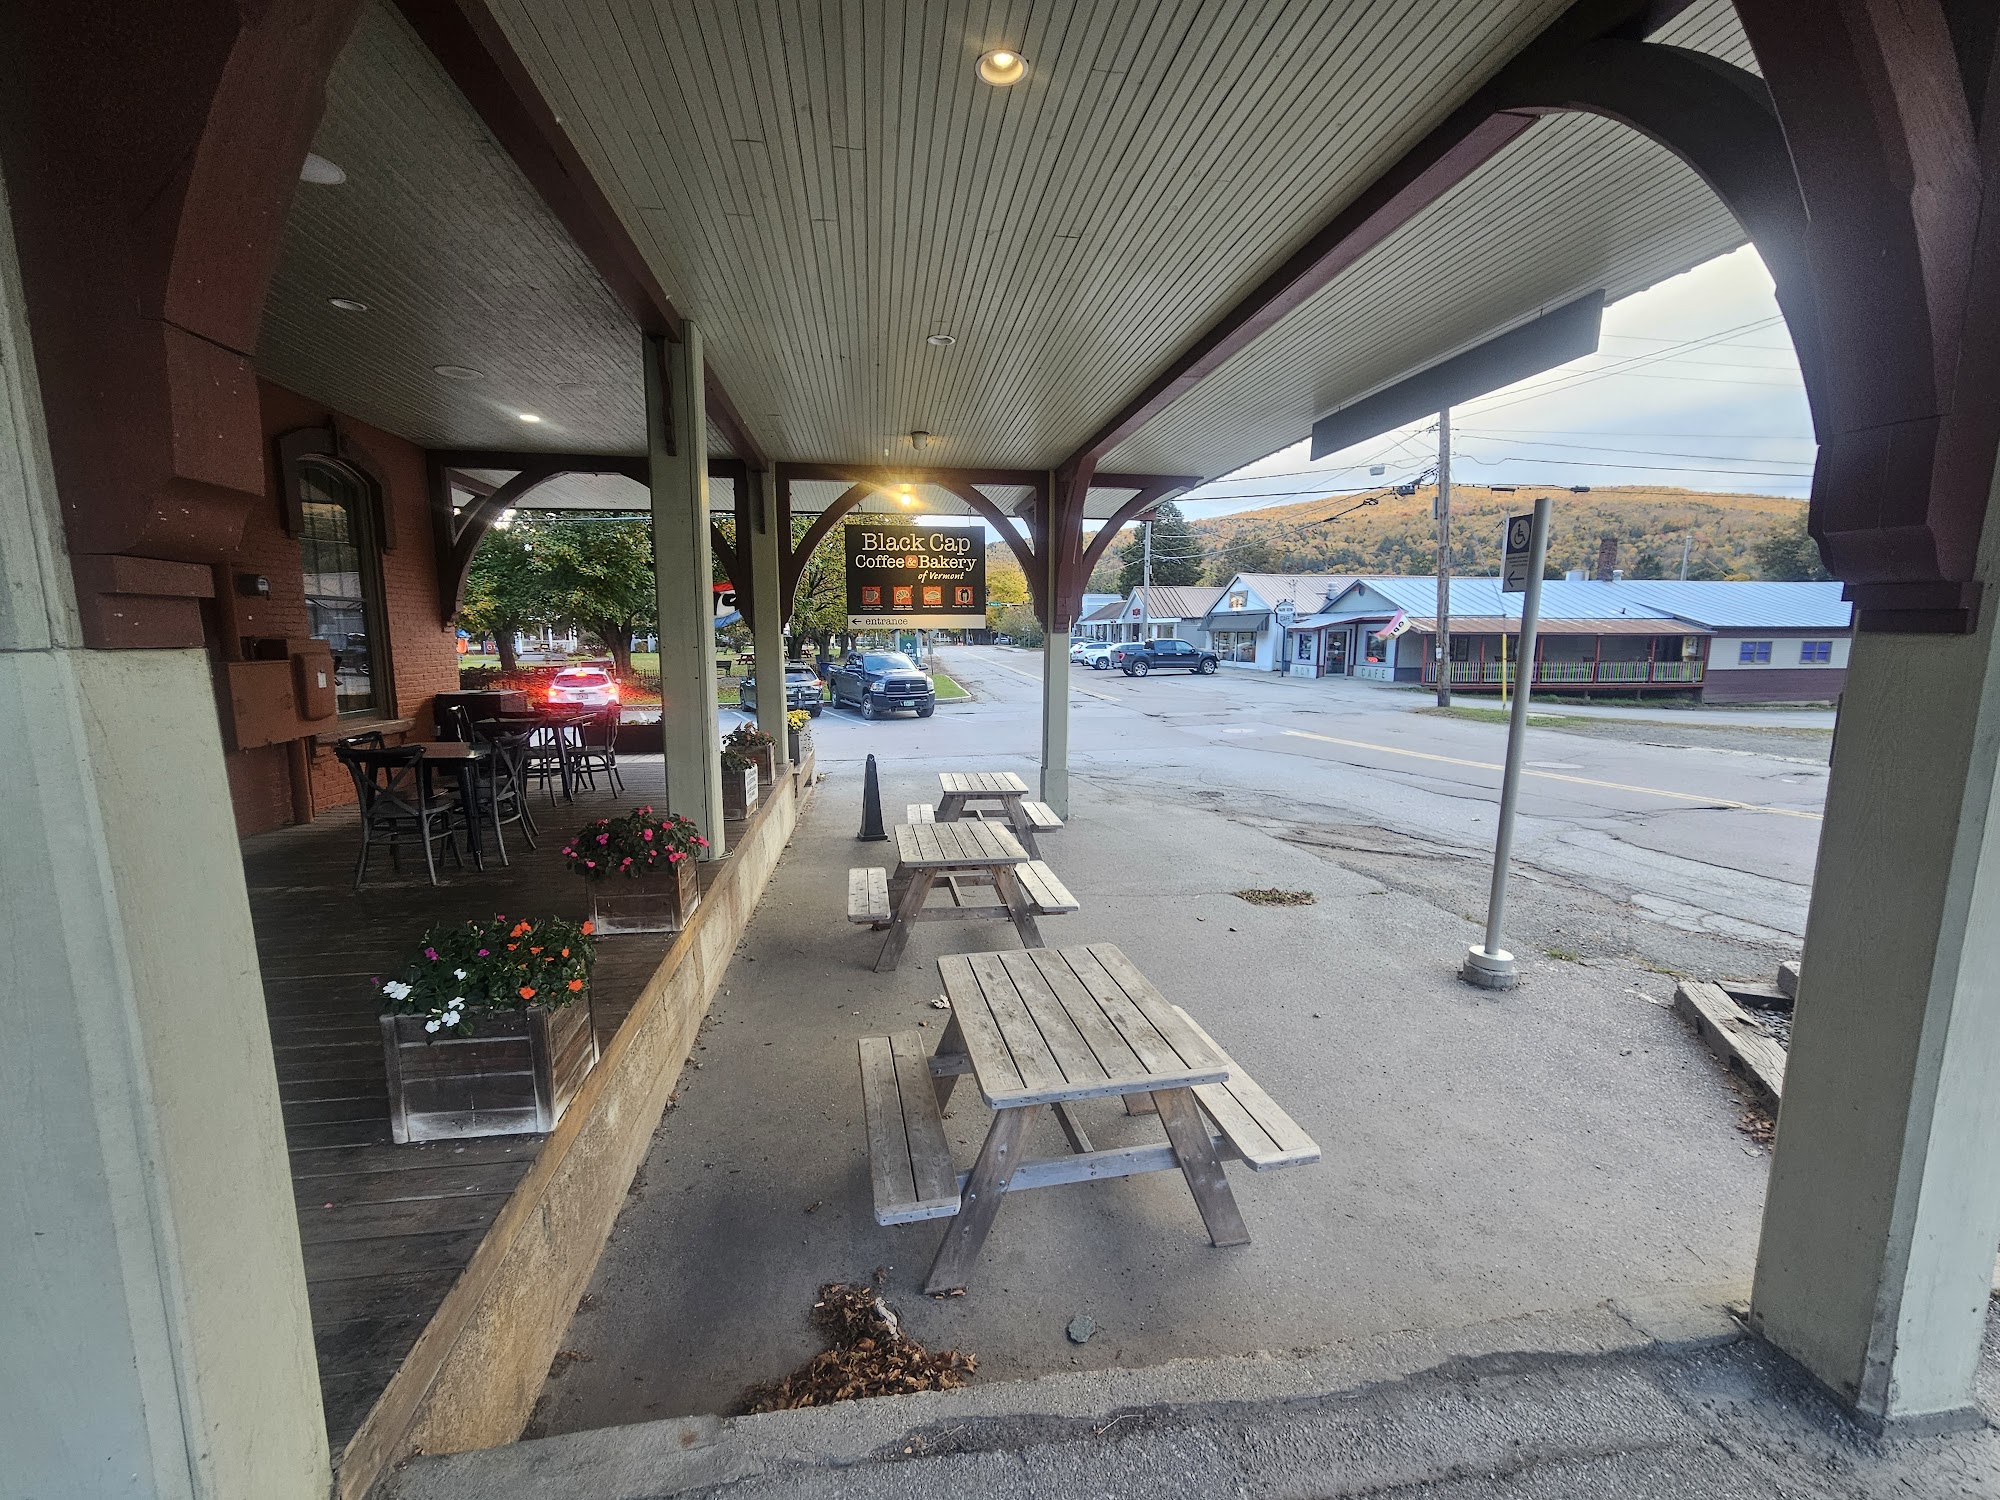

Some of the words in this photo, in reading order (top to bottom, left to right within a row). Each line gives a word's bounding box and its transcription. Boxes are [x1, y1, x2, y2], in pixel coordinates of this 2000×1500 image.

[861, 532, 925, 551] Black
[929, 533, 971, 555] Cap
[855, 554, 905, 569] Coffee
[918, 554, 977, 571] Bakery
[918, 570, 929, 583] of
[930, 571, 964, 580] Vermont
[865, 617, 909, 626] entrance
[1361, 668, 1386, 679] CAFE
